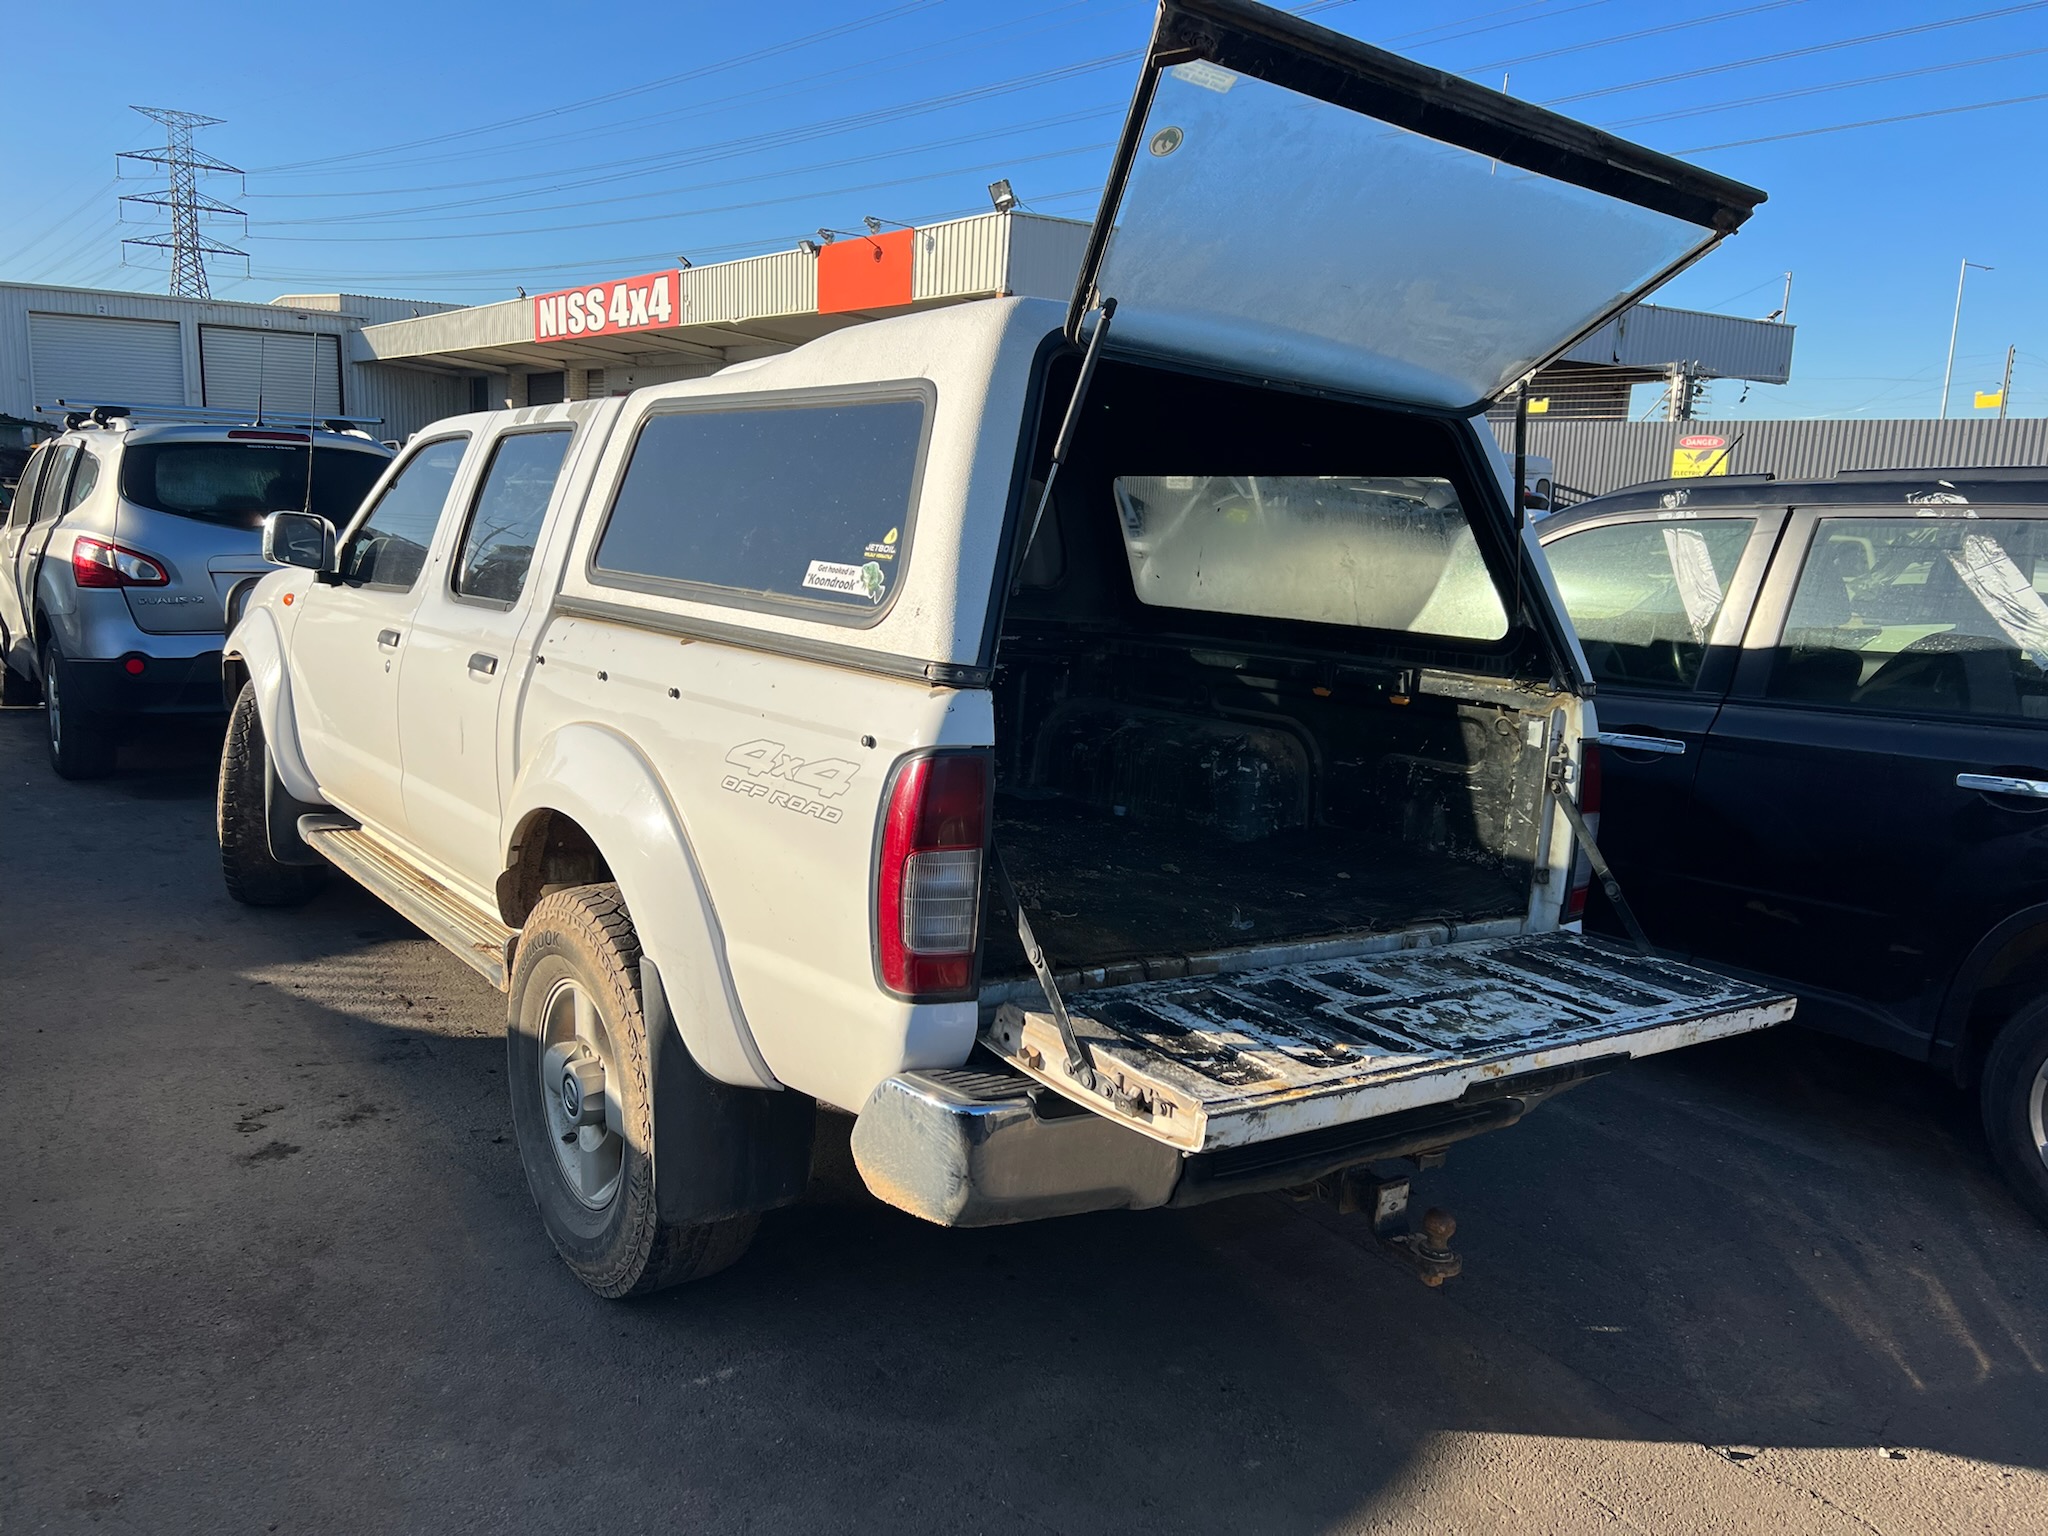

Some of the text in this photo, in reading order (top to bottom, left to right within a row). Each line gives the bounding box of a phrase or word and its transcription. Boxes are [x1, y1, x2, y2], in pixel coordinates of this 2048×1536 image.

[539, 274, 672, 338] NISS 4x4
[1685, 438, 1719, 446] DANGER
[865, 543, 896, 554] JETBOIL
[818, 564, 826, 572] Get
[828, 566, 848, 576] hooked
[138, 596, 188, 606] DUALIS
[725, 738, 861, 799] 4x4
[721, 775, 843, 824] OFF ROAD
